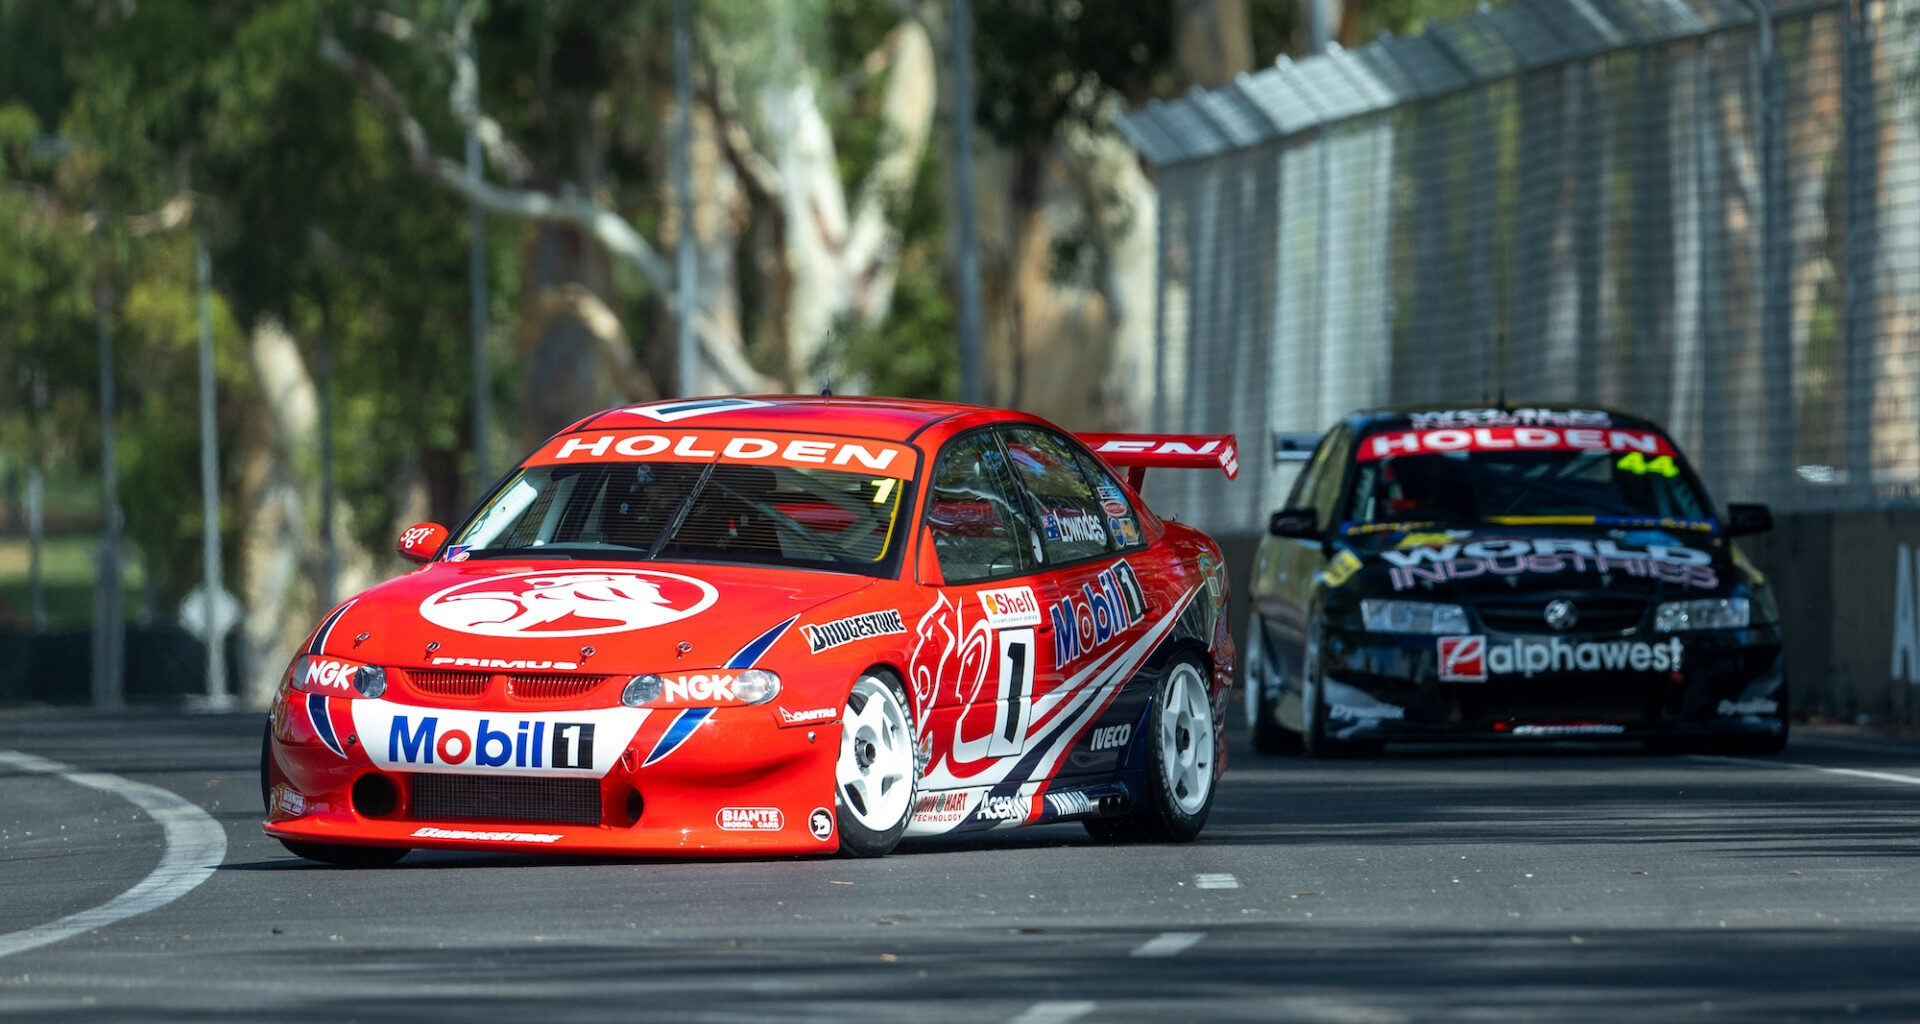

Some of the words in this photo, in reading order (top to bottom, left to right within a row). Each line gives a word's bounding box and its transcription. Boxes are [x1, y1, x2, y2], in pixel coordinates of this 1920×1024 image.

[555, 435, 899, 470] HOLDEN
[1371, 428, 1659, 456] HOLDEN
[1617, 451, 1680, 477] 44
[871, 478, 897, 503] 1
[1380, 537, 1713, 568] WORLD
[1390, 552, 1719, 591] INDUSTRIES
[994, 590, 1036, 615] Shell
[810, 610, 907, 652] BRIDGESTONE
[1049, 569, 1128, 670] Mobil
[431, 657, 579, 670] PRIMUS
[1488, 636, 1685, 678] alphawest
[304, 659, 359, 690] NGK
[664, 673, 736, 703] NGK
[1003, 642, 1027, 745] 1
[793, 707, 838, 721] QANTAS
[389, 715, 546, 767] Mobil
[1090, 723, 1132, 751] IVECO
[721, 809, 780, 822] BIANTE
[944, 792, 968, 812] HART
[722, 821, 754, 829] MODEL
[757, 821, 780, 829] CARS
[914, 813, 962, 822] TECHNOLOGY
